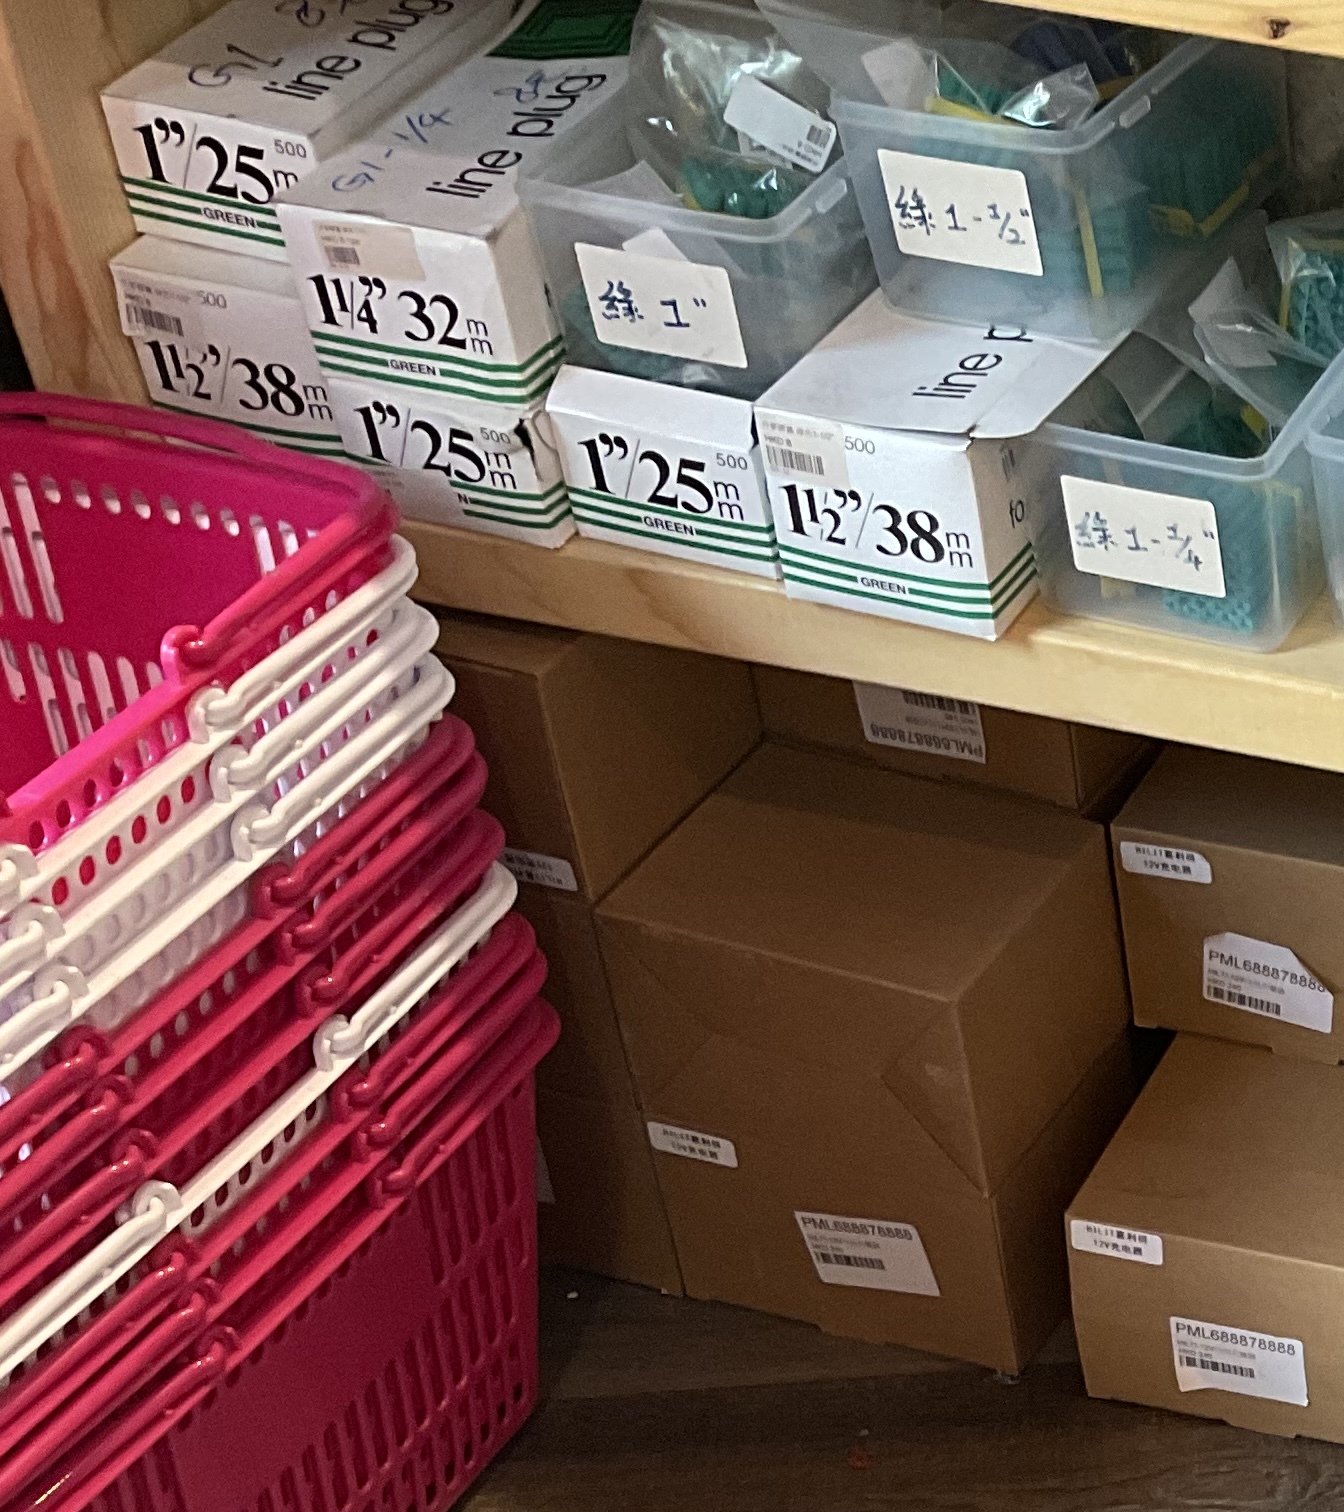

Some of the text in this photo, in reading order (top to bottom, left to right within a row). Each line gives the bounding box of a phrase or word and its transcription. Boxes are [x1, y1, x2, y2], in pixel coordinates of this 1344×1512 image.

[262, 55, 361, 101] line
[425, 150, 522, 198] line
[506, 73, 607, 137] plug
[274, 139, 307, 159] 500
[203, 206, 257, 230] GREEN
[390, 358, 437, 377] GREEN
[912, 352, 1003, 400] line
[480, 426, 512, 445] 500
[844, 436, 876, 455] 500
[716, 452, 748, 471] 500
[643, 516, 695, 537] GREEN
[860, 577, 907, 596] GREEN
[1175, 1321, 1296, 1356] PML688878888
